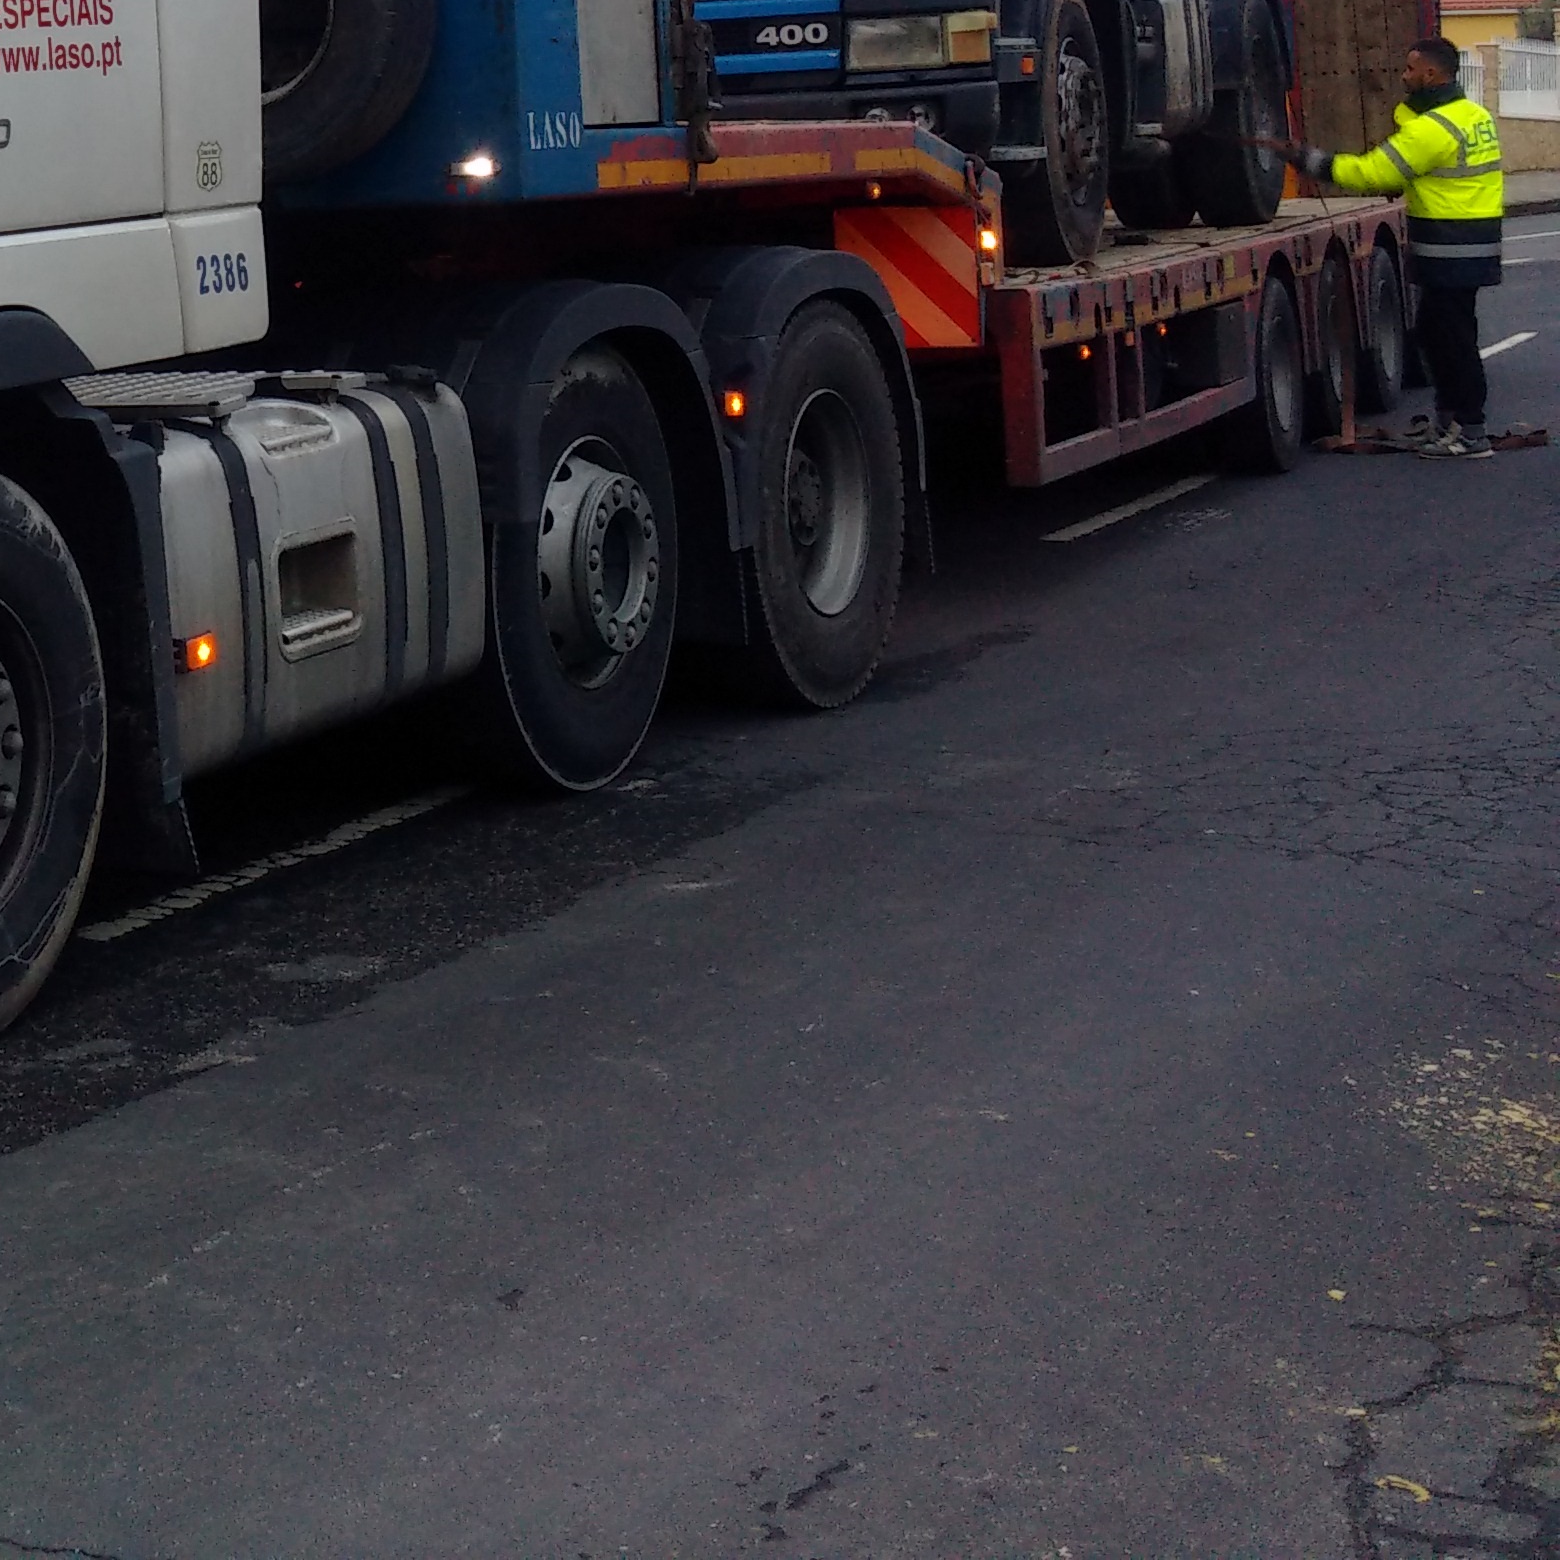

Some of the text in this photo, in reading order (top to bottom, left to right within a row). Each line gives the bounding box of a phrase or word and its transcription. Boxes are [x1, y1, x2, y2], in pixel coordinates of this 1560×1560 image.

[755, 21, 829, 47] 400
[527, 110, 583, 151] LASO
[201, 162, 218, 186] 88
[196, 253, 249, 295] 2386
